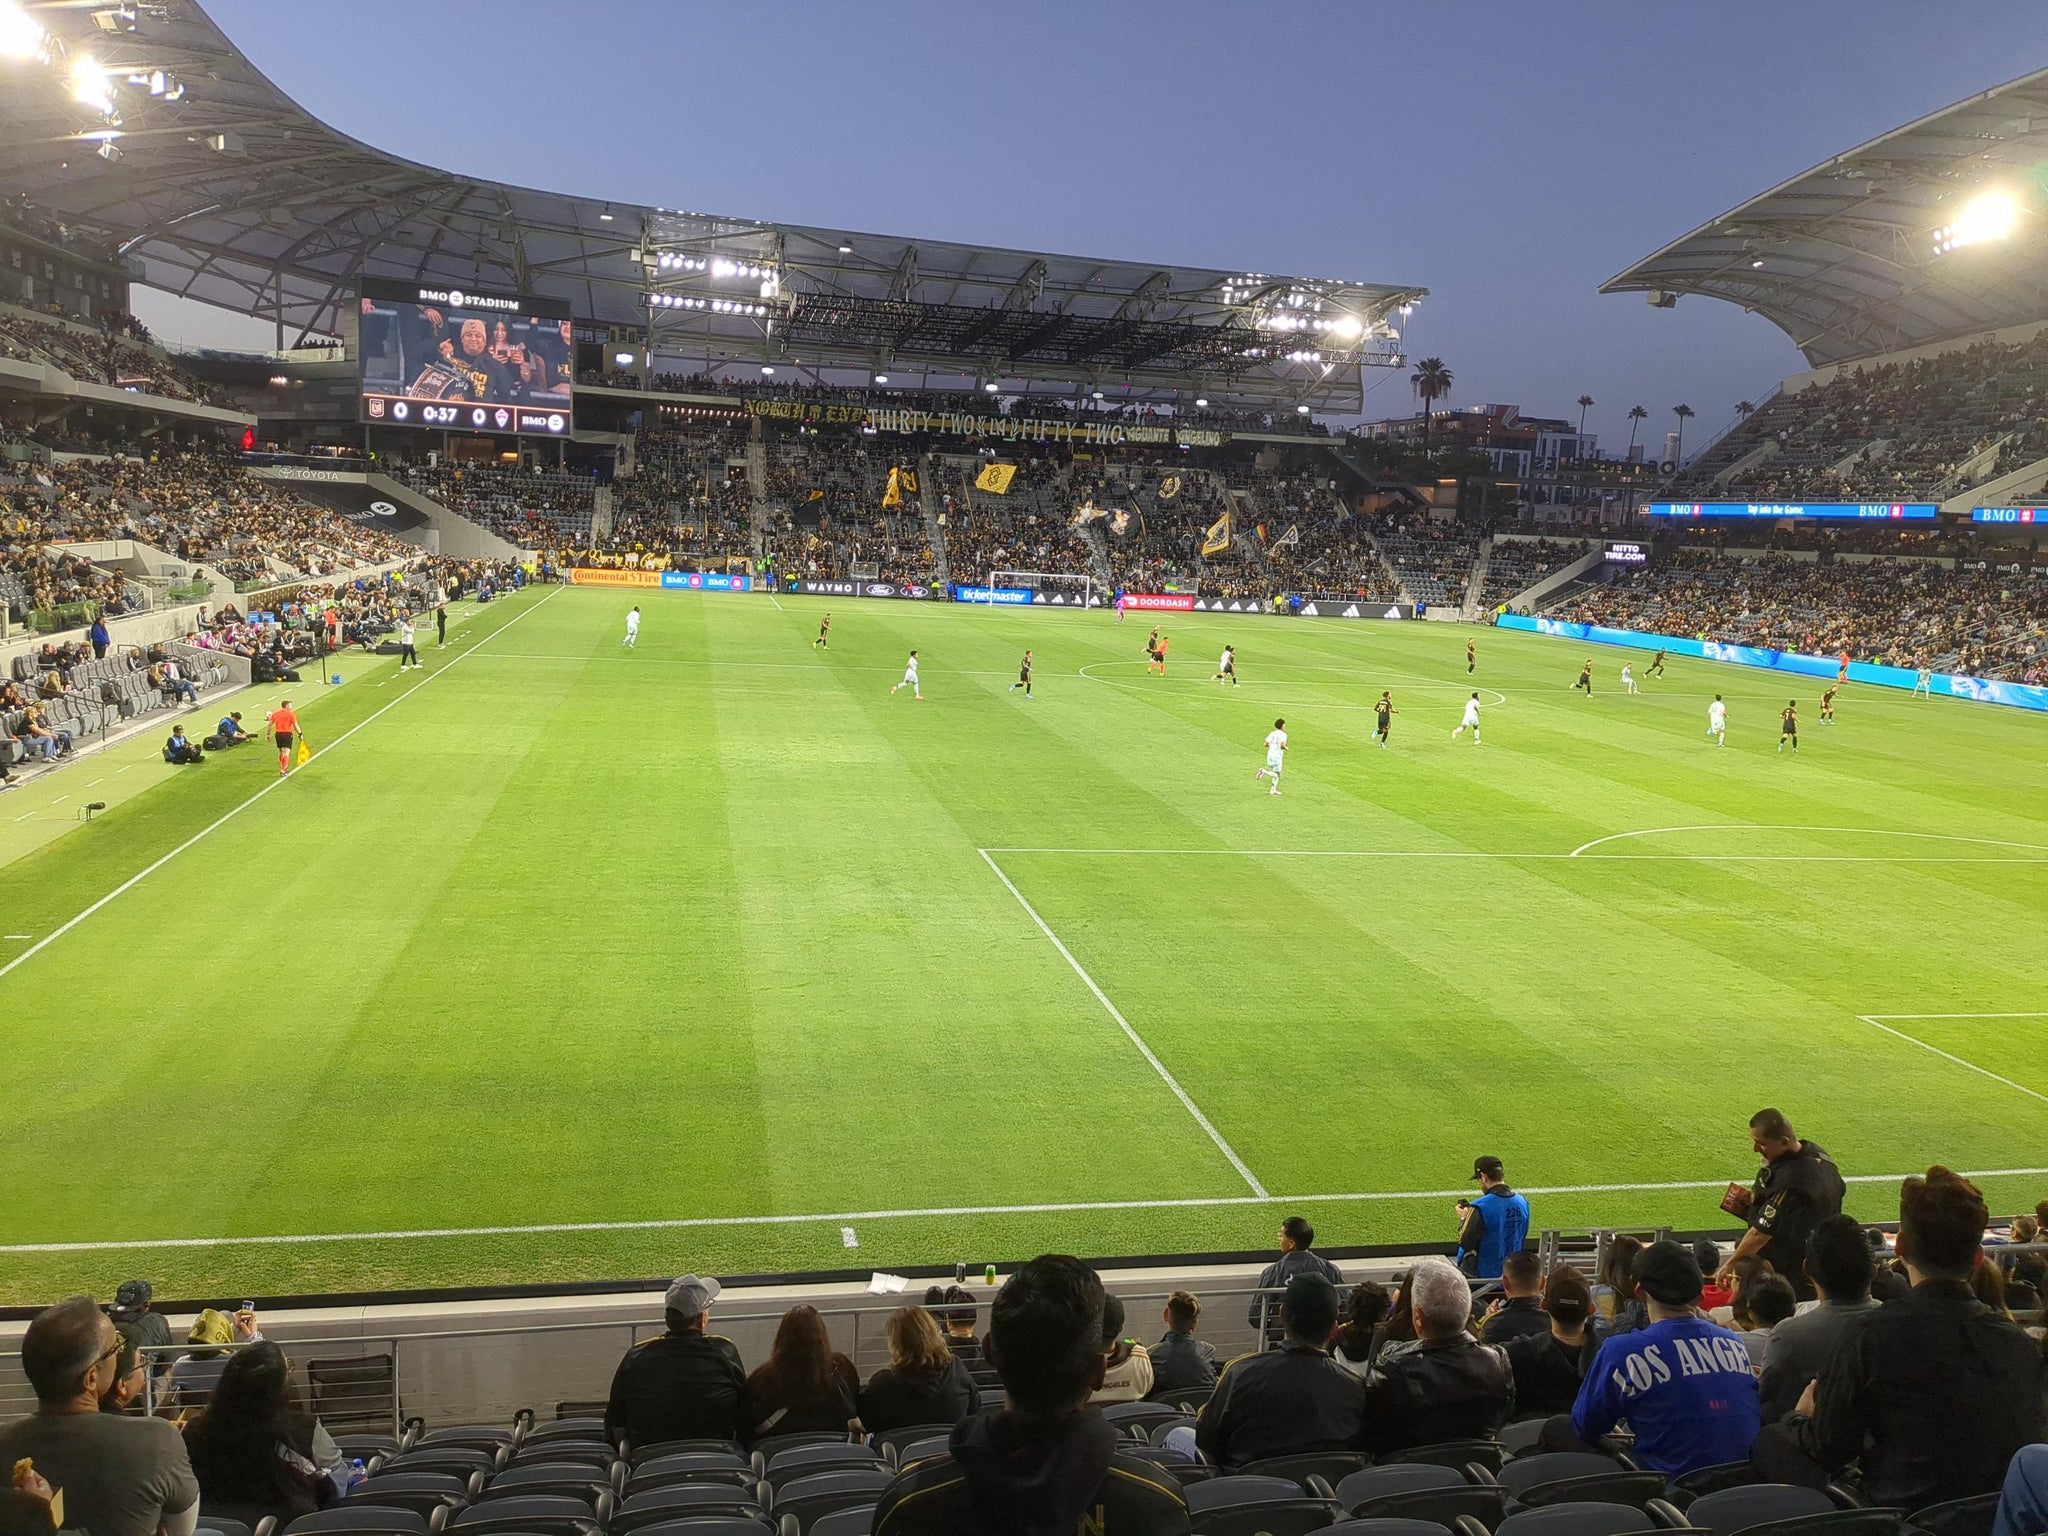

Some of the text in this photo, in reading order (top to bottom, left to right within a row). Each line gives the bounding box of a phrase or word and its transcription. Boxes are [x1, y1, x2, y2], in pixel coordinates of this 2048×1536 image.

[420, 289, 519, 310] BMO STADIUM
[393, 401, 408, 419] 0
[423, 406, 458, 421] 0:37
[744, 400, 865, 423] NORTH END
[472, 408, 486, 425] 0
[522, 416, 546, 426] BMO
[868, 408, 933, 433] THIRTY
[938, 412, 975, 435] TWO
[1020, 418, 1078, 441] FIFTY
[1085, 422, 1123, 445] TWO
[297, 470, 339, 481] TOYOTA
[1670, 504, 1690, 514] BMO
[1747, 504, 1805, 515] Tap into the Game.
[1859, 505, 1888, 517] BMO
[1983, 509, 2016, 521] BMO
[1612, 544, 1640, 553] NITTO
[1604, 552, 1646, 561] TIRE.COM
[573, 570, 660, 583] Continental Tire
[666, 576, 687, 584] BMO
[707, 578, 729, 586] BMO
[806, 582, 853, 593] WAYMO
[963, 591, 1026, 603] ticketmaster
[1140, 599, 1190, 608] DOORDASH
[1612, 1344, 1672, 1397] LOS
[1103, 1380, 1131, 1389] NGELES
